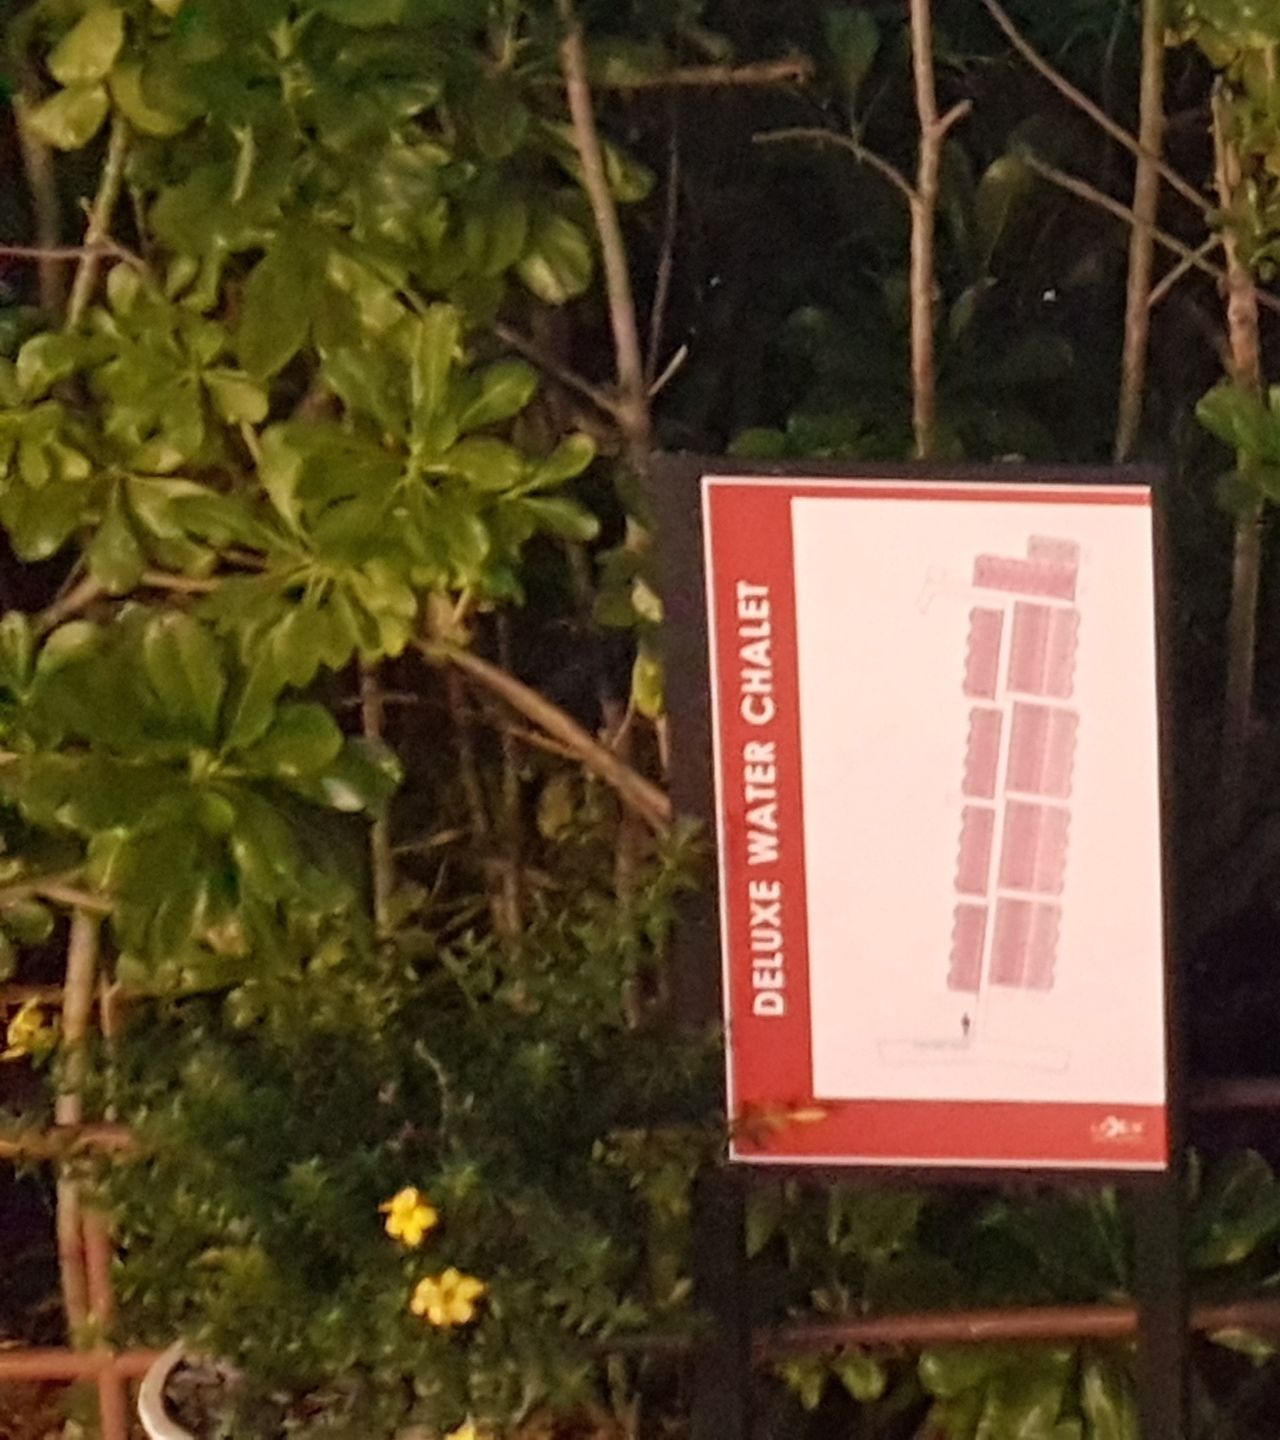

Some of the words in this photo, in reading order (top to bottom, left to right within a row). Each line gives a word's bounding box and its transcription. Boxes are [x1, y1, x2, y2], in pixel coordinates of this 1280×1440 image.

[736, 579, 776, 726] CHALET
[743, 740, 780, 866] WATER
[748, 880, 785, 1017] DELUXE
